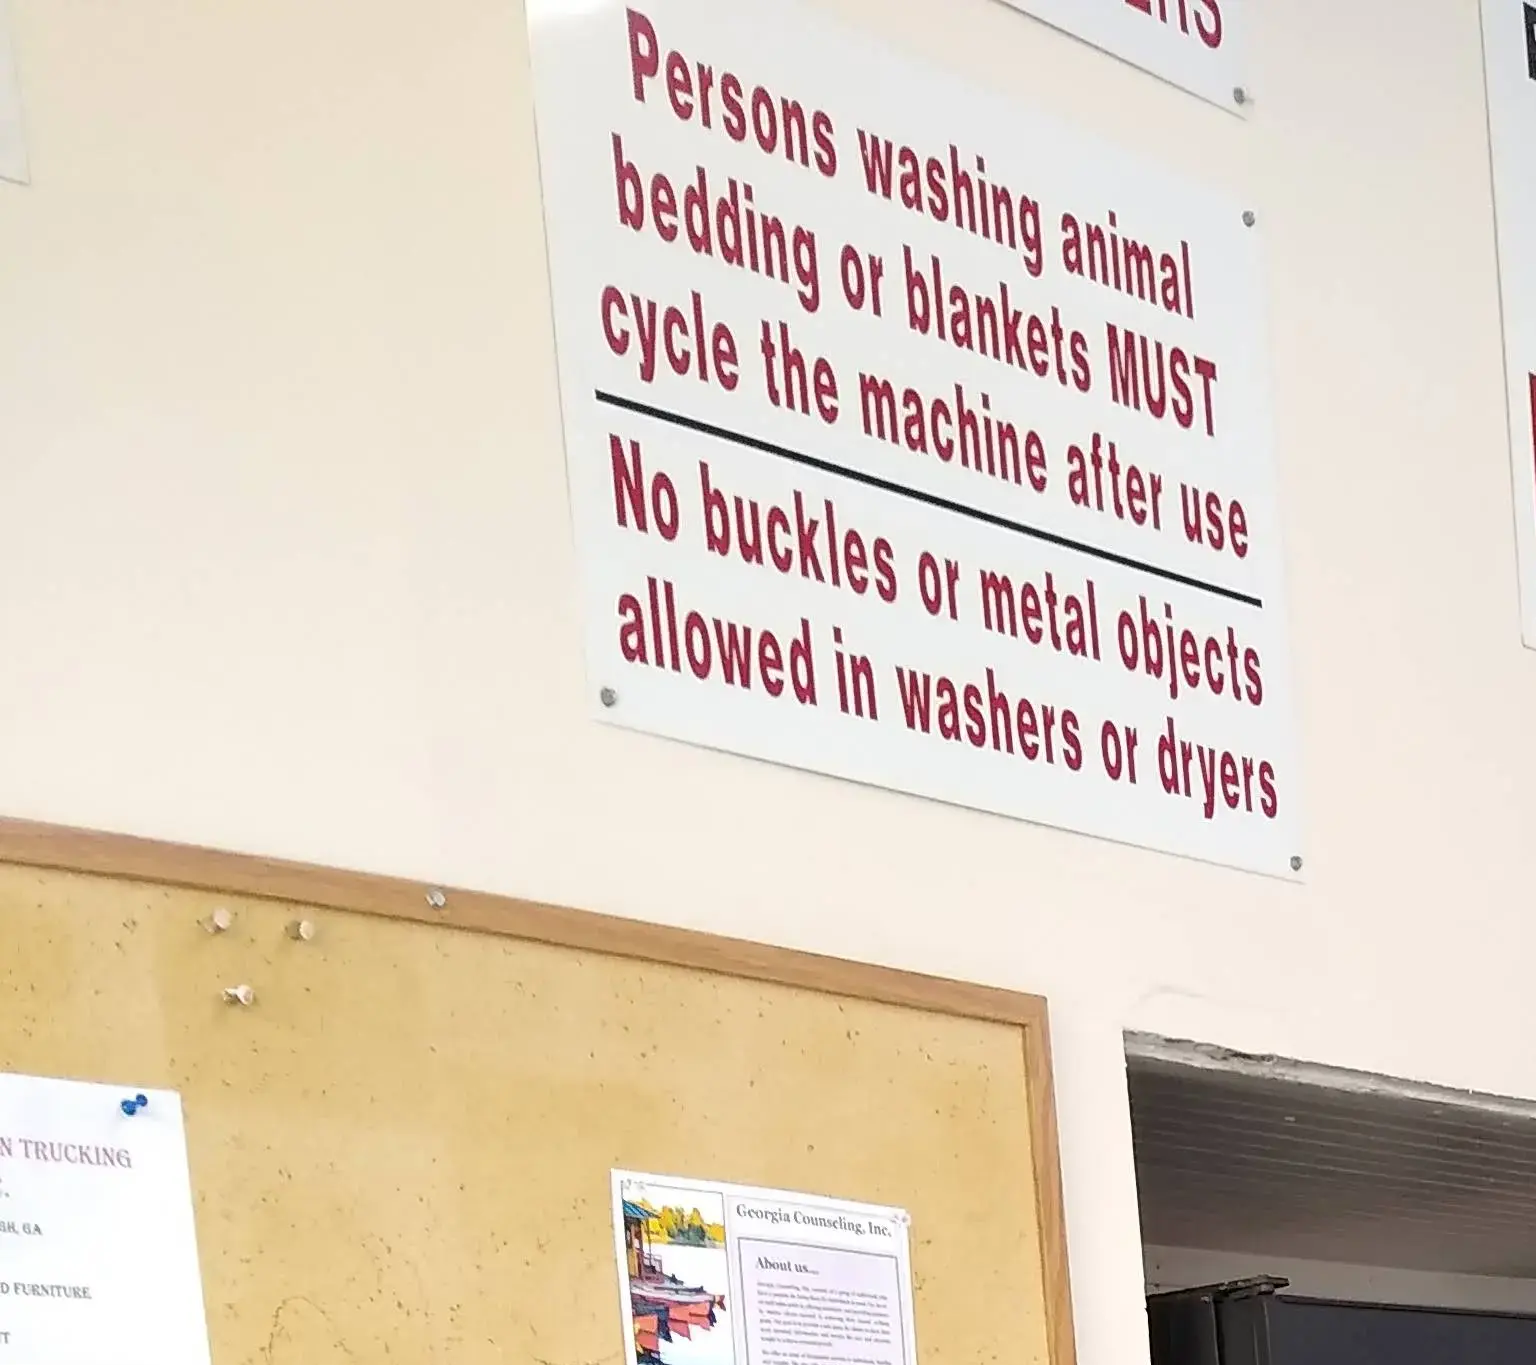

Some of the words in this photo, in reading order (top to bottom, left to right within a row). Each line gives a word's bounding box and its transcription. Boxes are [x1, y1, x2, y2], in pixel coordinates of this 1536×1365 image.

[612, 132, 819, 313] bedding
[840, 243, 884, 318] or
[904, 246, 1091, 394] blankets
[1108, 325, 1217, 436] MUST
[626, 7, 838, 177] Persons
[858, 128, 1043, 276] washing
[1060, 210, 1194, 320] animal
[600, 282, 739, 391] cycle
[762, 321, 838, 423] the
[859, 371, 1047, 492] machine
[1067, 434, 1162, 531] after
[1180, 484, 1250, 559] use
[608, 434, 679, 541] No
[701, 463, 897, 603] buckles
[919, 551, 959, 615] or
[979, 563, 1098, 661] metal
[1117, 598, 1264, 705] objects
[619, 577, 817, 707] allowed
[835, 624, 878, 721] in
[897, 667, 1082, 771] washers
[1101, 726, 1137, 784] or
[1157, 719, 1278, 819] dryers
[19, 1138, 132, 1168] TRUCKING
[736, 1203, 790, 1223] Georgia
[794, 1210, 866, 1235] Counseling,
[868, 1221, 892, 1237] Inc.
[756, 1257, 792, 1272] About
[14, 1282, 92, 1300] FURNITURE
